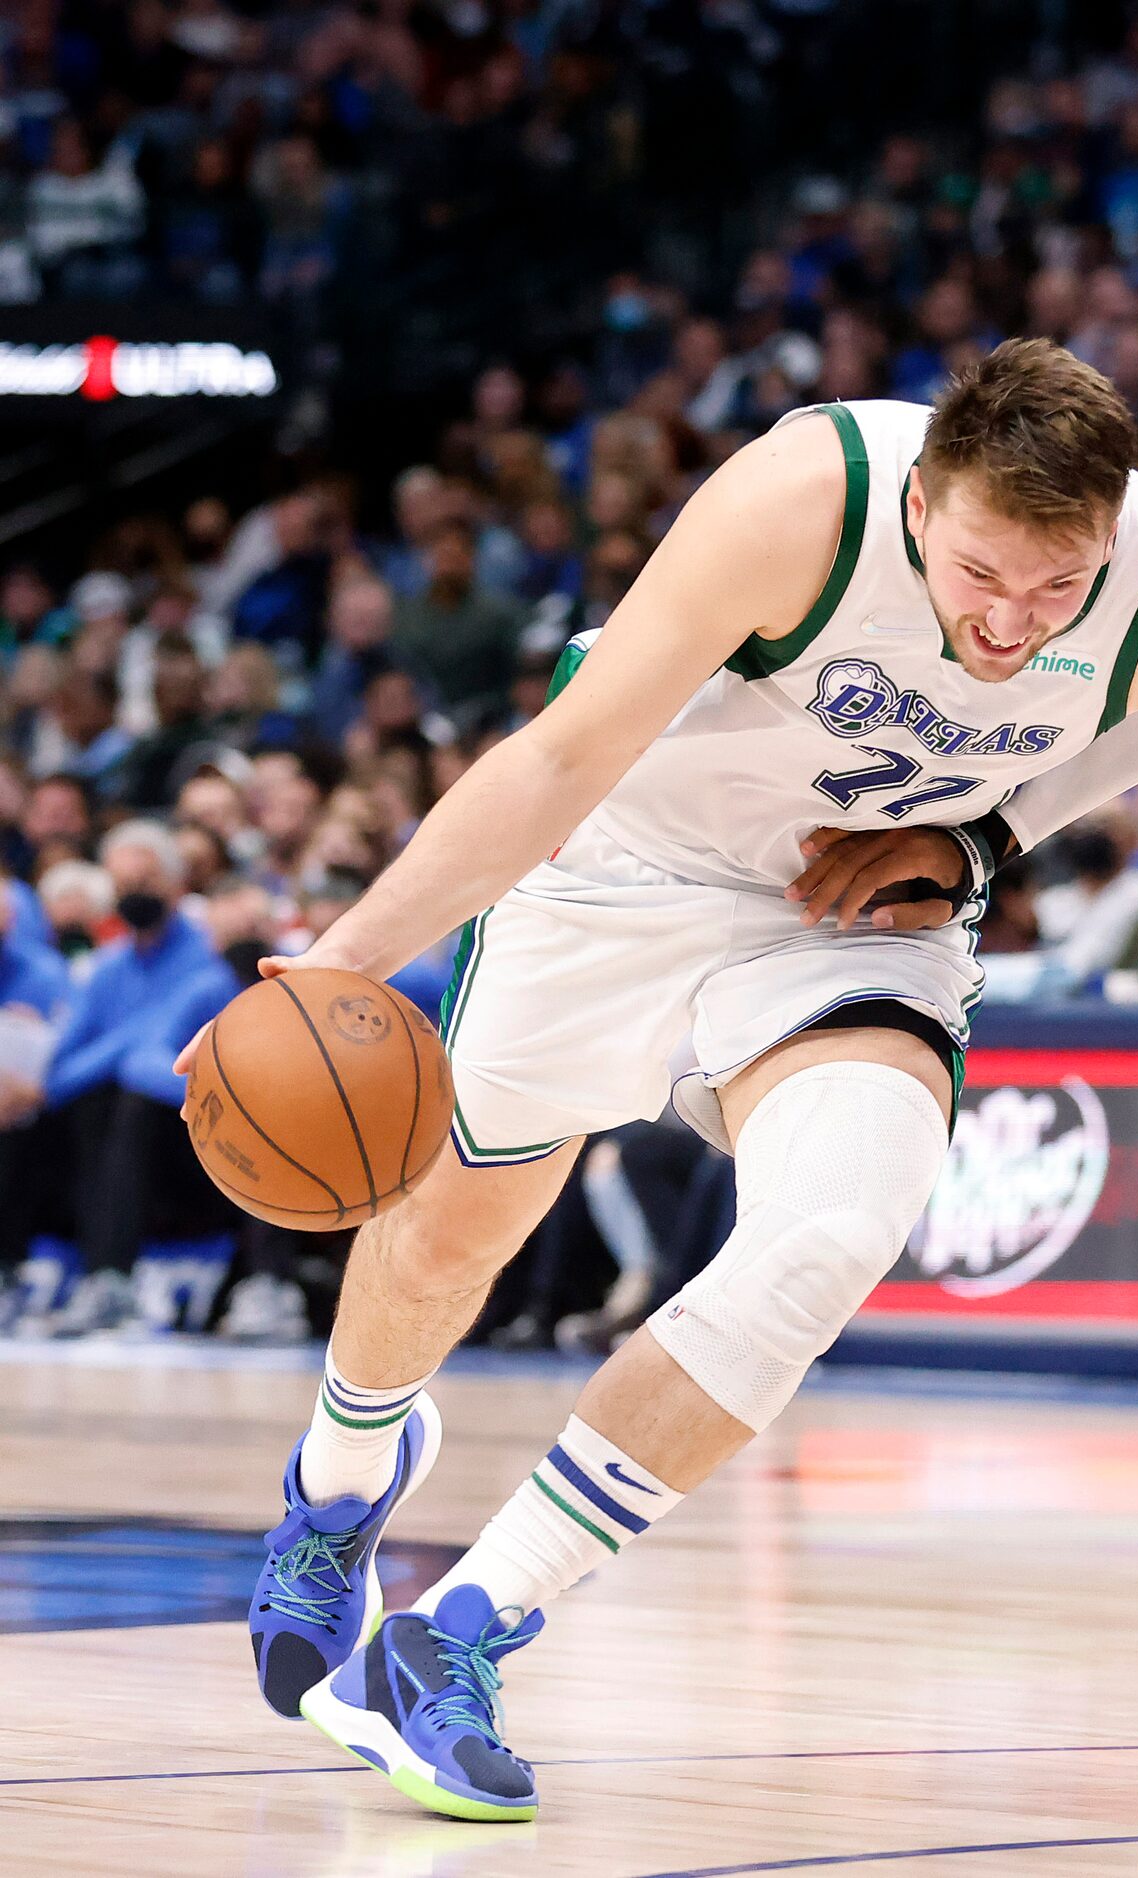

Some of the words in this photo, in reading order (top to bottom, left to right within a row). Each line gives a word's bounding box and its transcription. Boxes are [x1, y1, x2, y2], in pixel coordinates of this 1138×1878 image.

[1022, 650, 1095, 681] hime
[806, 684, 1064, 756] DALLAS
[812, 744, 987, 821] 77
